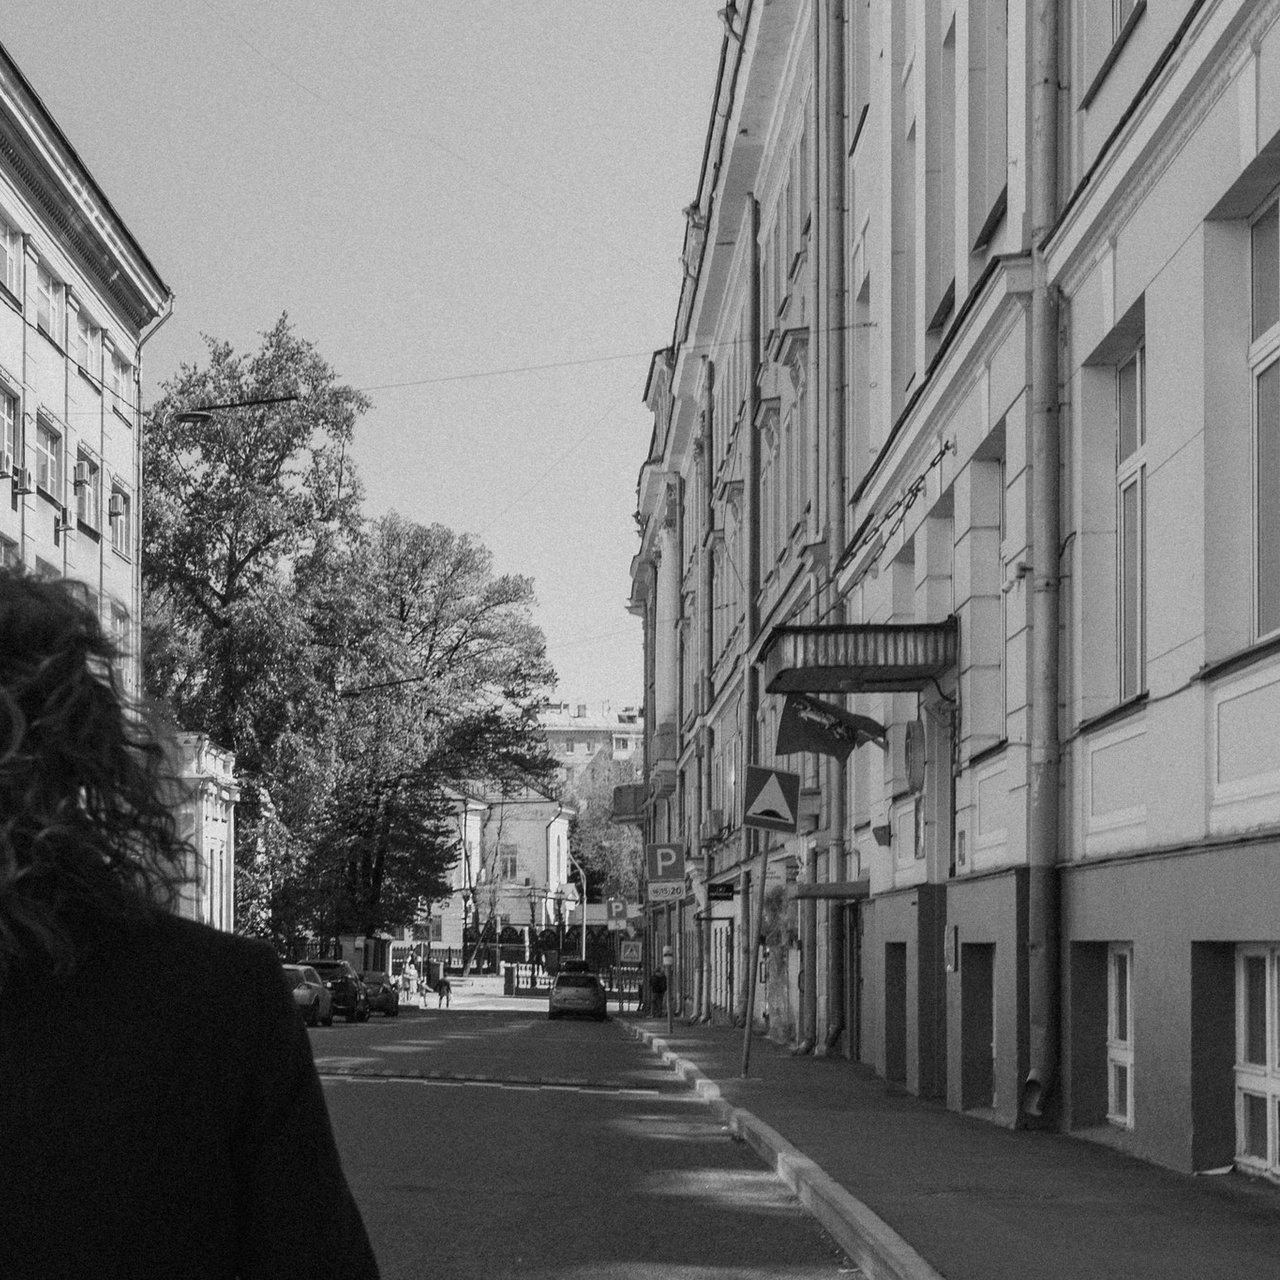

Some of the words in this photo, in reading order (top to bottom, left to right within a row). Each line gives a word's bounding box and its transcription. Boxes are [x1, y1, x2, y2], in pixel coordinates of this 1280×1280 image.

[657, 848, 676, 876] P
[671, 886, 682, 895] 20
[612, 902, 623, 916] P
